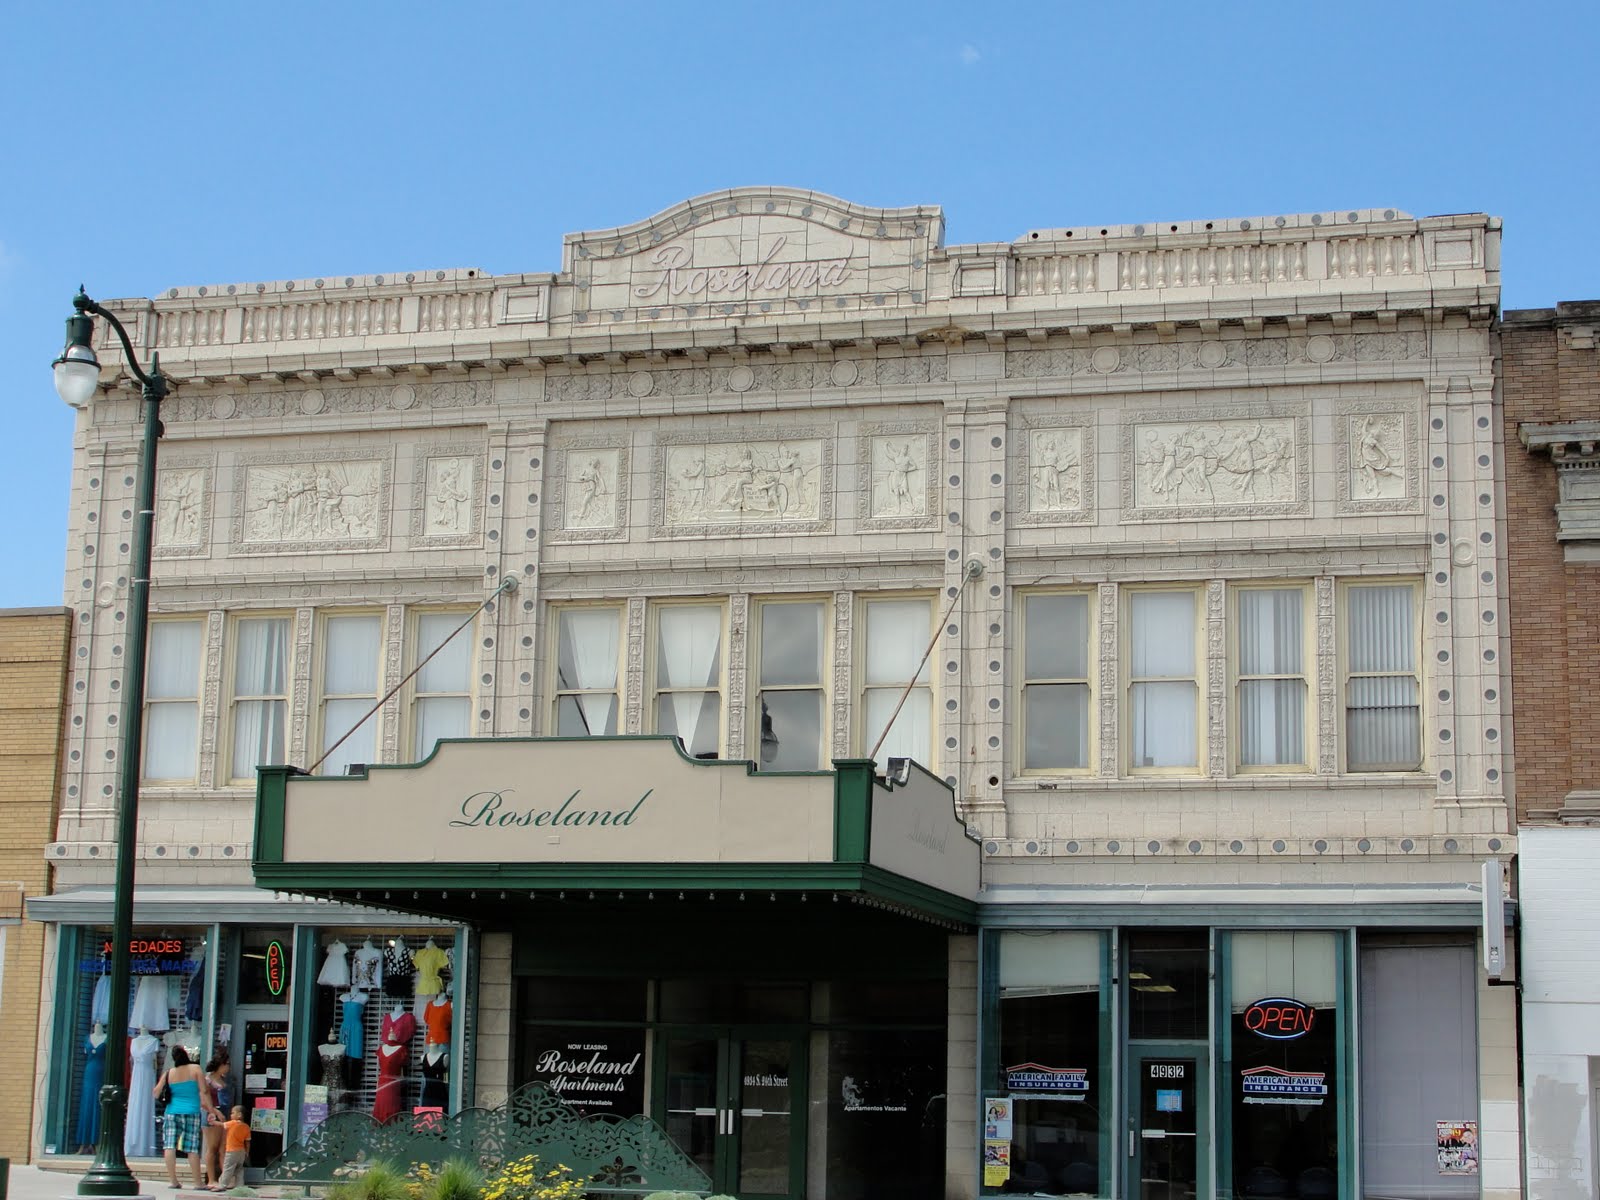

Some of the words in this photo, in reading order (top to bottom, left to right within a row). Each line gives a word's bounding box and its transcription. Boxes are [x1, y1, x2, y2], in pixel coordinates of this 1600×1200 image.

[634, 233, 855, 298] Roseland
[448, 788, 655, 828] Roseland
[104, 940, 182, 953] NEDADES
[269, 945, 280, 990] OPEN
[1245, 1006, 1315, 1031] OPEN
[267, 1037, 288, 1048] OPEN
[536, 1049, 641, 1075] Roseland
[1008, 1073, 1052, 1081] AMERICAN
[1151, 1065, 1184, 1078] 4932
[549, 1074, 625, 1093] Apartments
[773, 1073, 788, 1087] Street
[1243, 1076, 1289, 1084] AMERICAN
[1290, 1077, 1323, 1085] FAMILY
